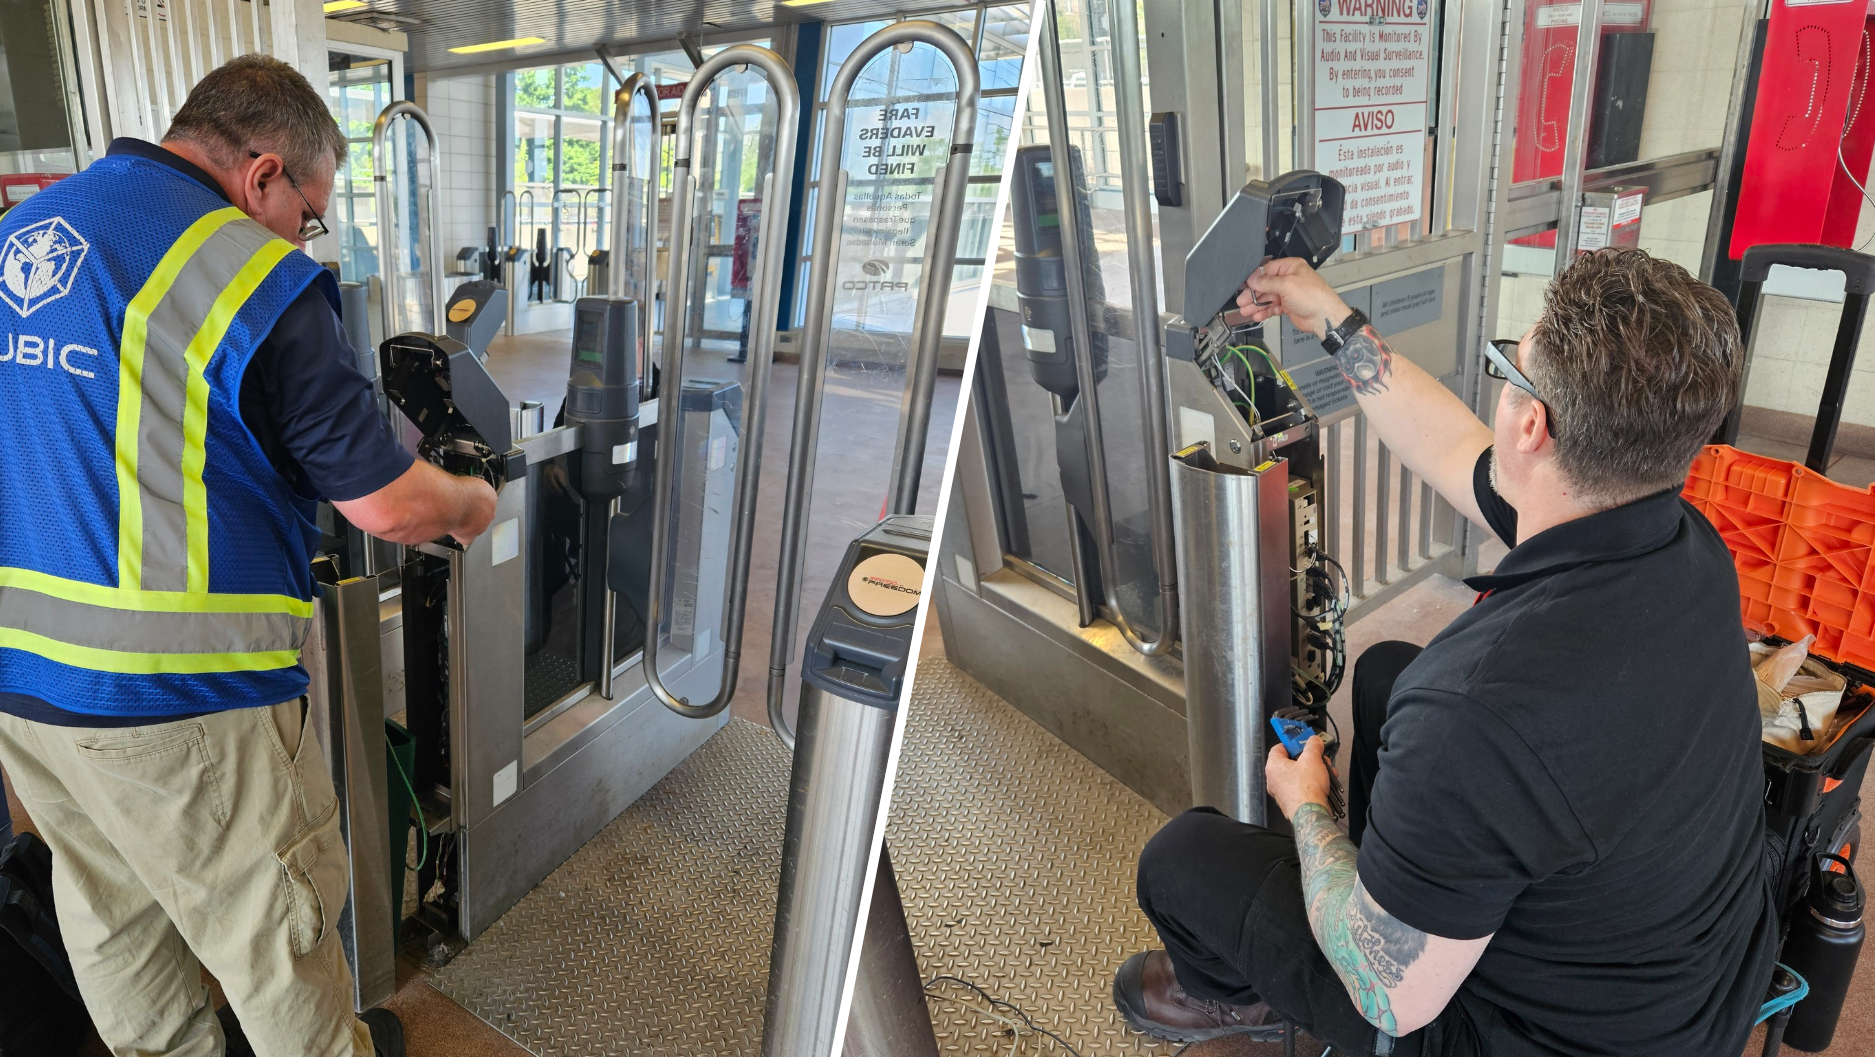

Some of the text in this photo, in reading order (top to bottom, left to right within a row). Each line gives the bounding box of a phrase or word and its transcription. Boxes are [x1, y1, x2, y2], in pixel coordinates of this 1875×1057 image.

[1338, 0, 1413, 18] WARNING
[1322, 29, 1422, 46] This Facility Is Monitored By
[1321, 48, 1424, 62] Audio And Visual Surveillance.
[1330, 65, 1415, 83] By entering, you consent
[671, 86, 684, 96] AID
[1343, 83, 1403, 100] to being recorded
[1352, 109, 1395, 132] AVISO
[1339, 141, 1403, 161] Ésta instalación es
[1329, 159, 1411, 179] monitoreada por audio y
[1361, 180, 1381, 192] visual.
[1385, 176, 1391, 188] Al
[1394, 175, 1413, 186] entrar,
[1350, 198, 1358, 210] da
[1361, 190, 1409, 208] consentimiento
[1349, 213, 1363, 226] esta
[1366, 209, 1386, 221] siendo
[1389, 204, 1415, 222] grabado.
[1389, 297, 1406, 307] children
[1411, 293, 1422, 301] years
[1402, 303, 1412, 311] must
[1294, 336, 1304, 345] fare
[0, 332, 98, 379] UBIC
